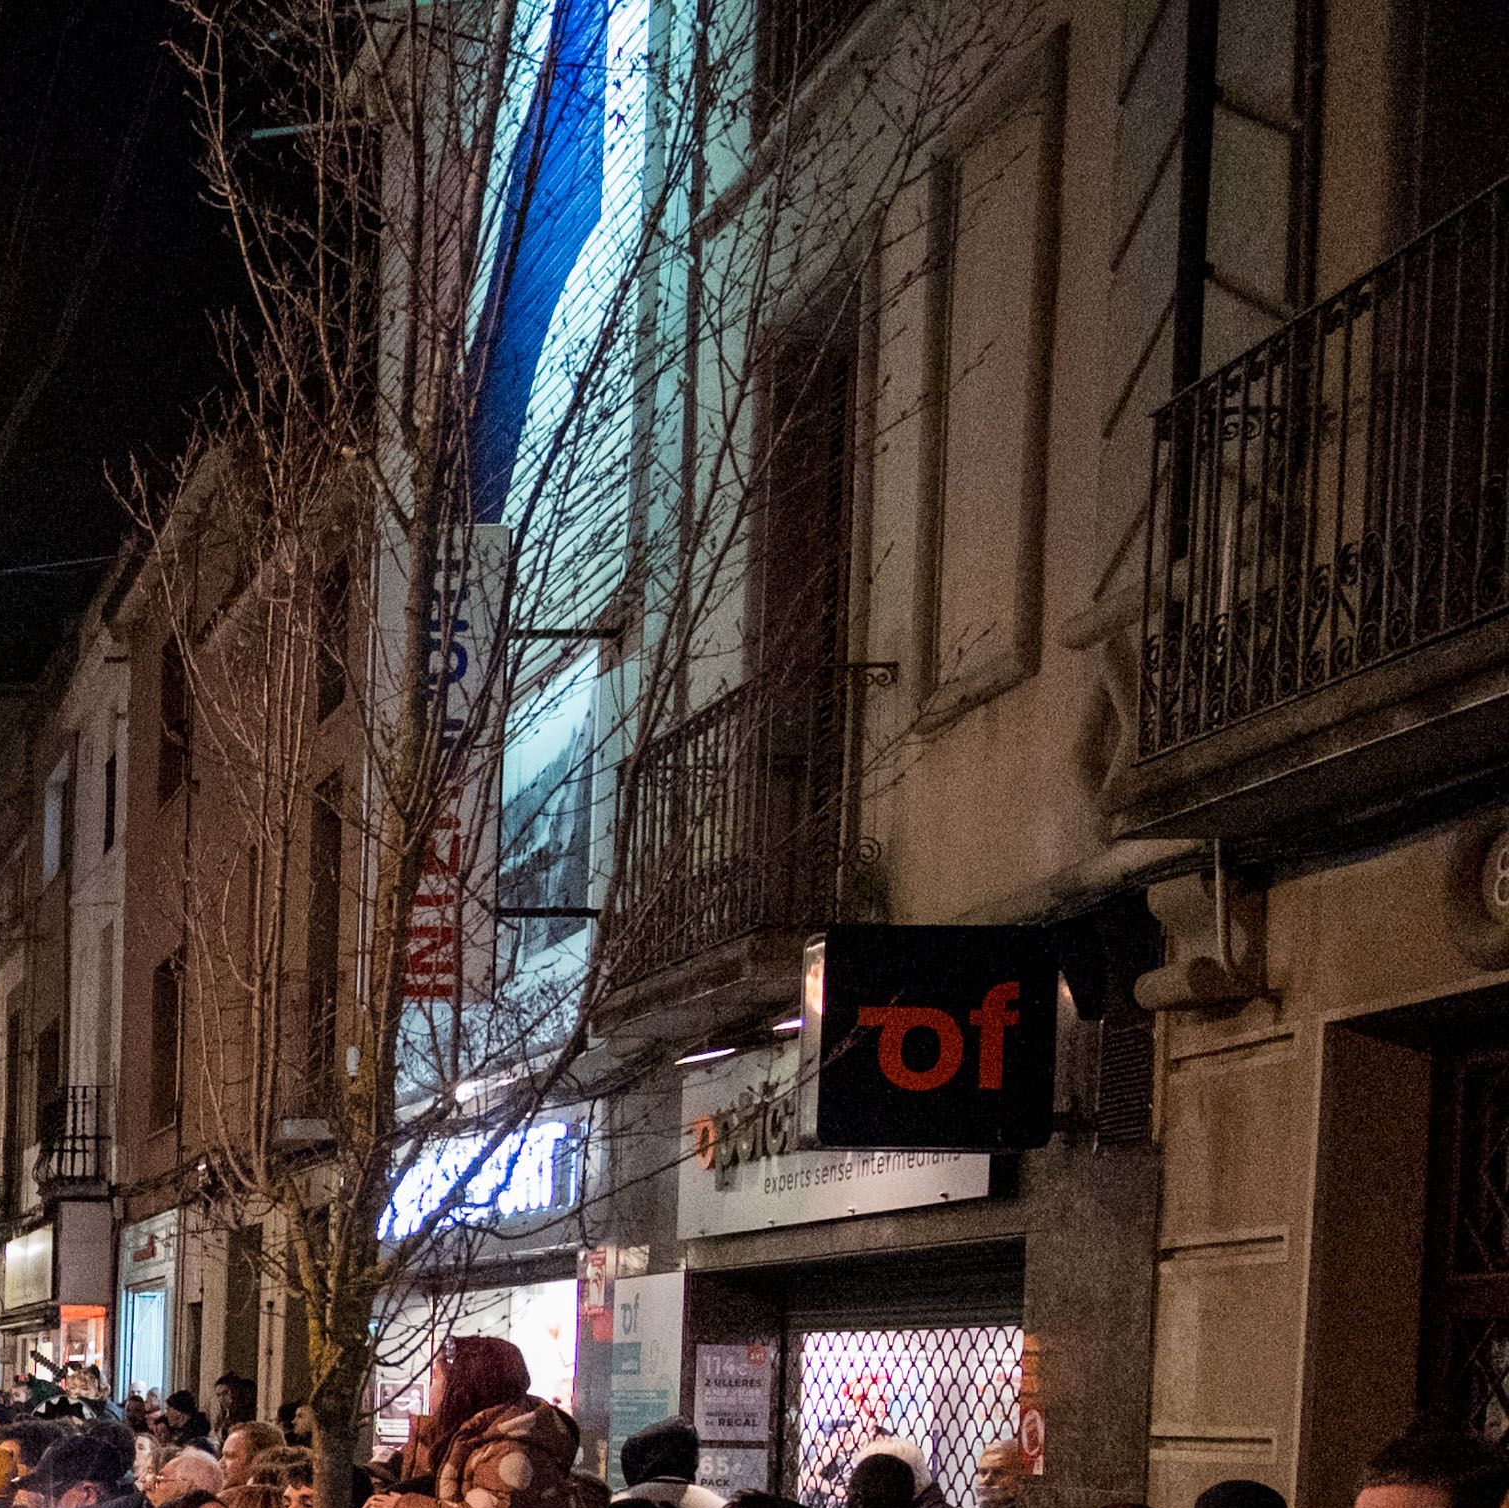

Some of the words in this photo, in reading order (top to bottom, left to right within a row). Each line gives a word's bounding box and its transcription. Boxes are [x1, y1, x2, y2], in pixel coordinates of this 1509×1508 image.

[764, 1168, 811, 1195] experts
[814, 1160, 854, 1185] sense
[704, 1378, 711, 1387] 2
[714, 1378, 763, 1388] ULLERES
[718, 1418, 759, 1428] REGAL
[700, 1478, 731, 1488] PACK
